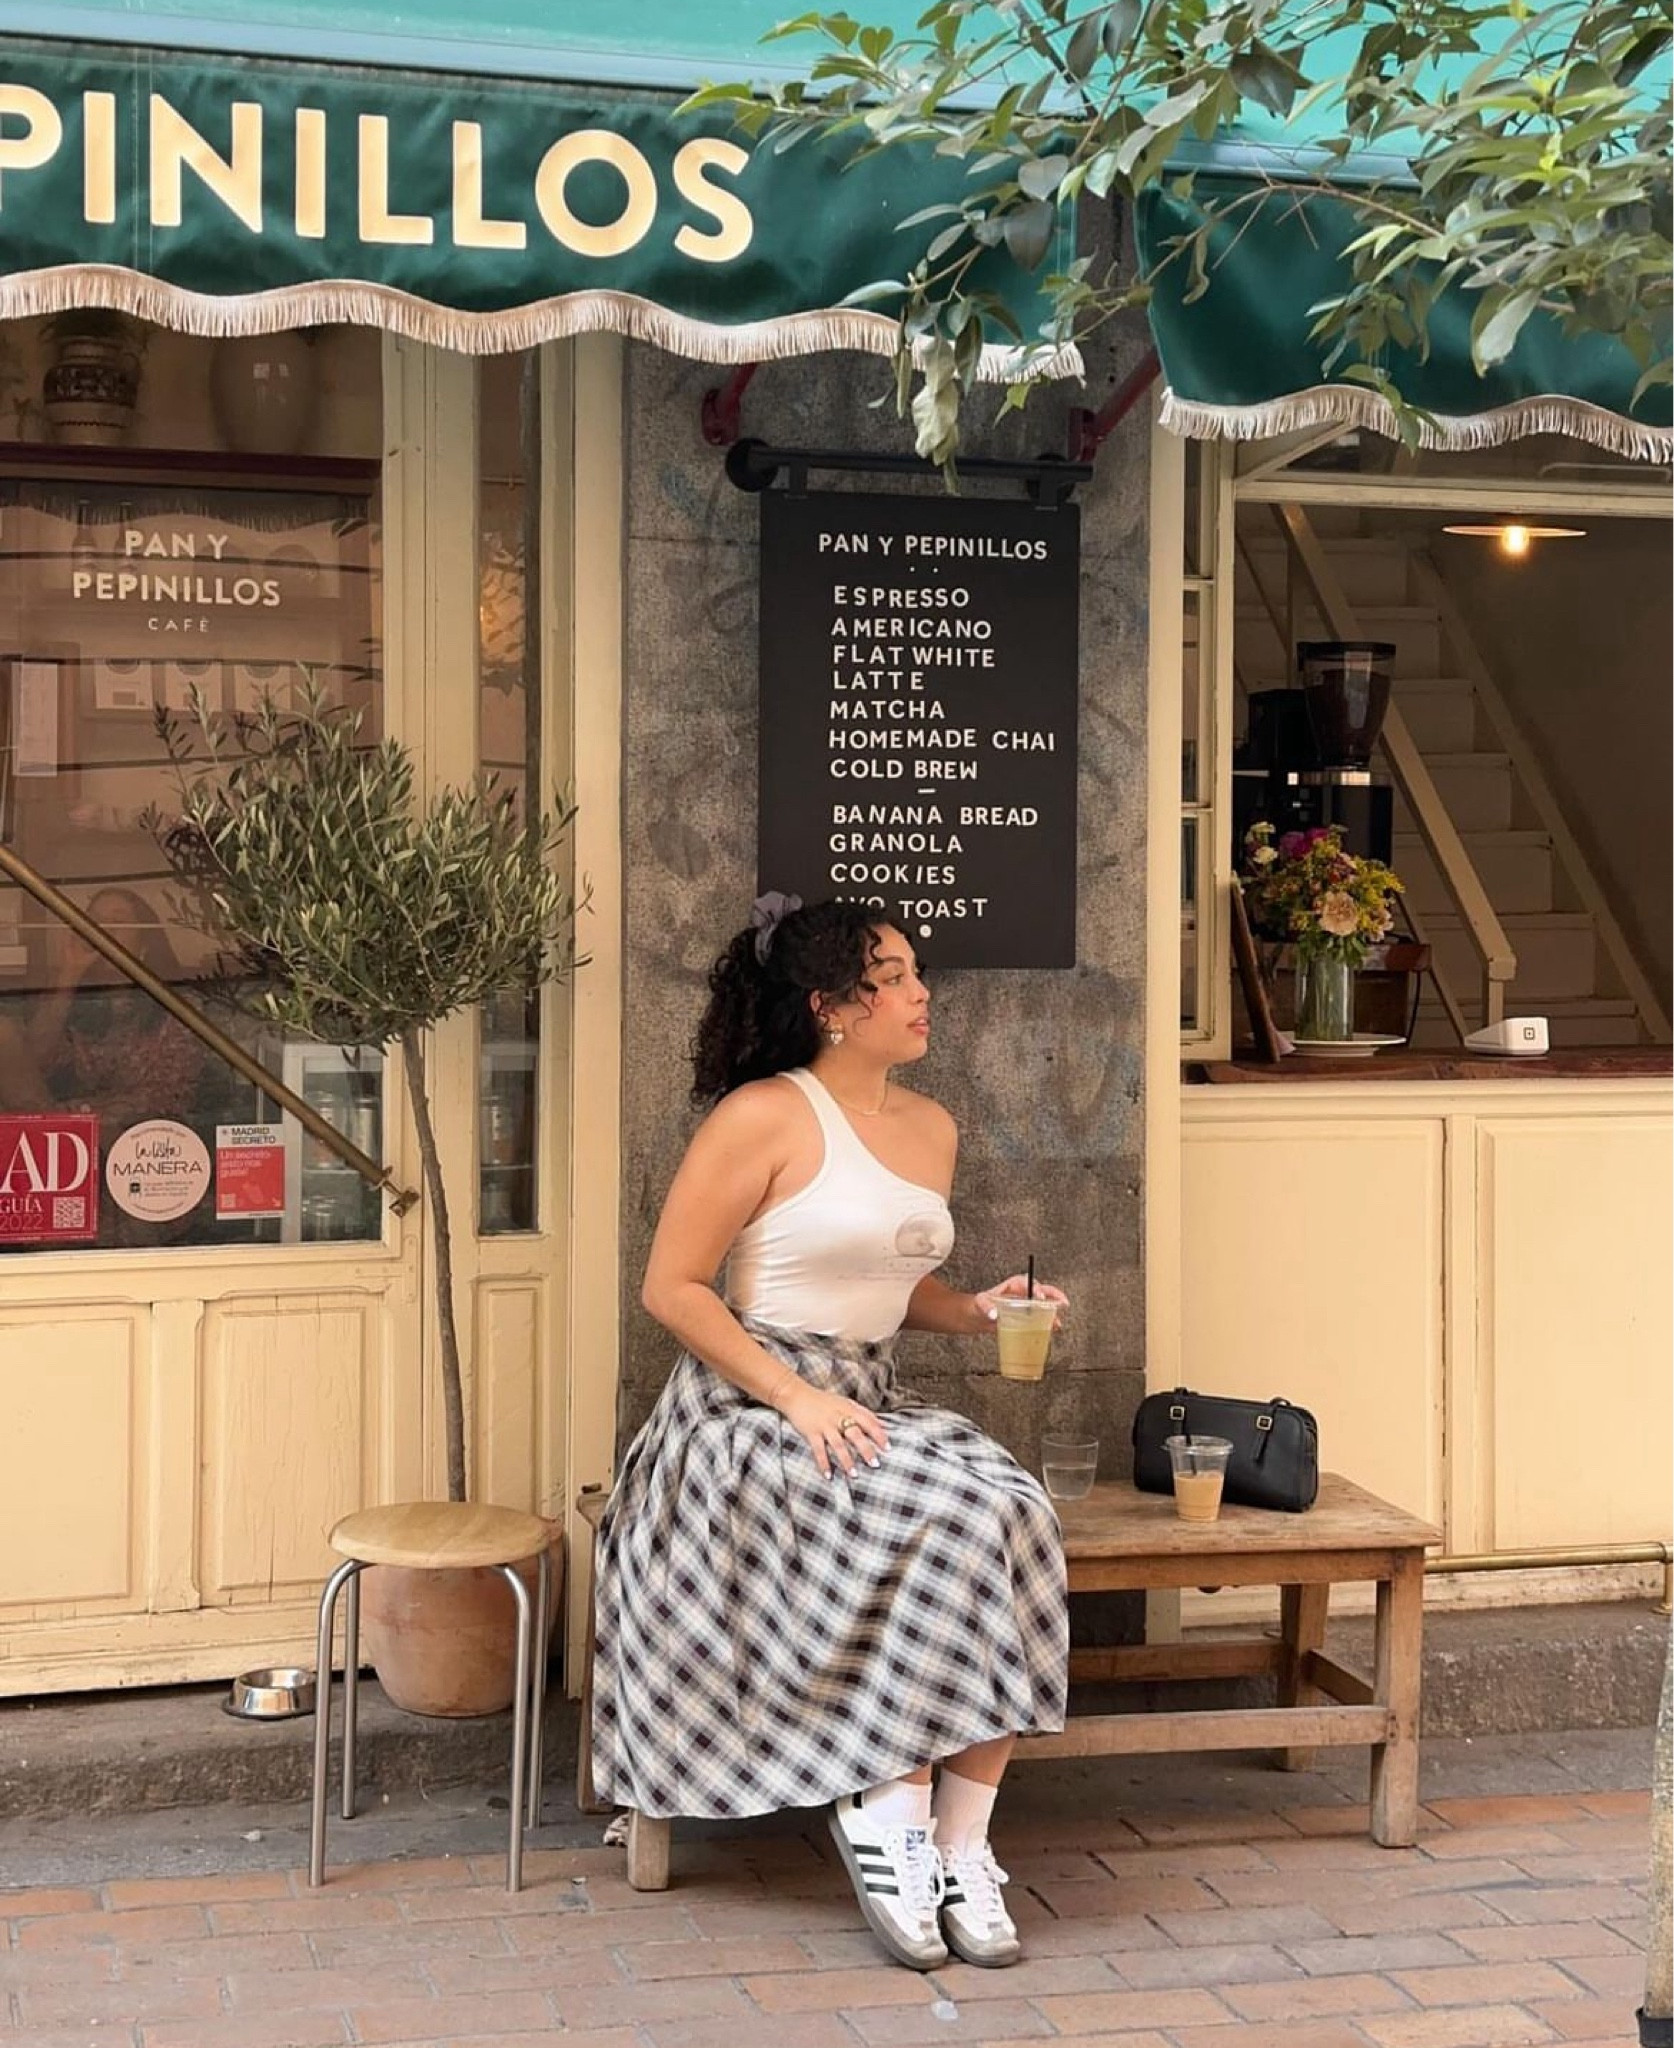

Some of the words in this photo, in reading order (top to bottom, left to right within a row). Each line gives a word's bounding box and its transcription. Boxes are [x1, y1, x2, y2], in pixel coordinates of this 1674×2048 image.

[124, 530, 196, 558] PAN
[206, 533, 229, 560] Y
[819, 533, 869, 554] PAN
[878, 536, 893, 556] Y
[905, 535, 1048, 560] PEPINILLOS
[72, 571, 280, 607] PEPINILLOS
[834, 585, 969, 609] ESPRESSO
[831, 617, 992, 640] AMERICANO
[833, 643, 905, 666] FLAT
[911, 646, 995, 668] WHITE
[833, 670, 924, 691] LATTE
[830, 699, 945, 720] MATCHA
[829, 728, 978, 750] HOMEMADE
[992, 730, 1055, 752] CHAI
[830, 758, 904, 779] COLD
[914, 760, 978, 780] BREW
[833, 804, 943, 826] BANANA
[960, 806, 1038, 826] BREAD
[829, 832, 964, 854] GRANOLA
[830, 863, 955, 885] COOKIES
[898, 897, 988, 919] TOAST
[0, 1131, 89, 1193] AD
[113, 1160, 203, 1176] MANERA
[0, 1213, 44, 1231] 2022
